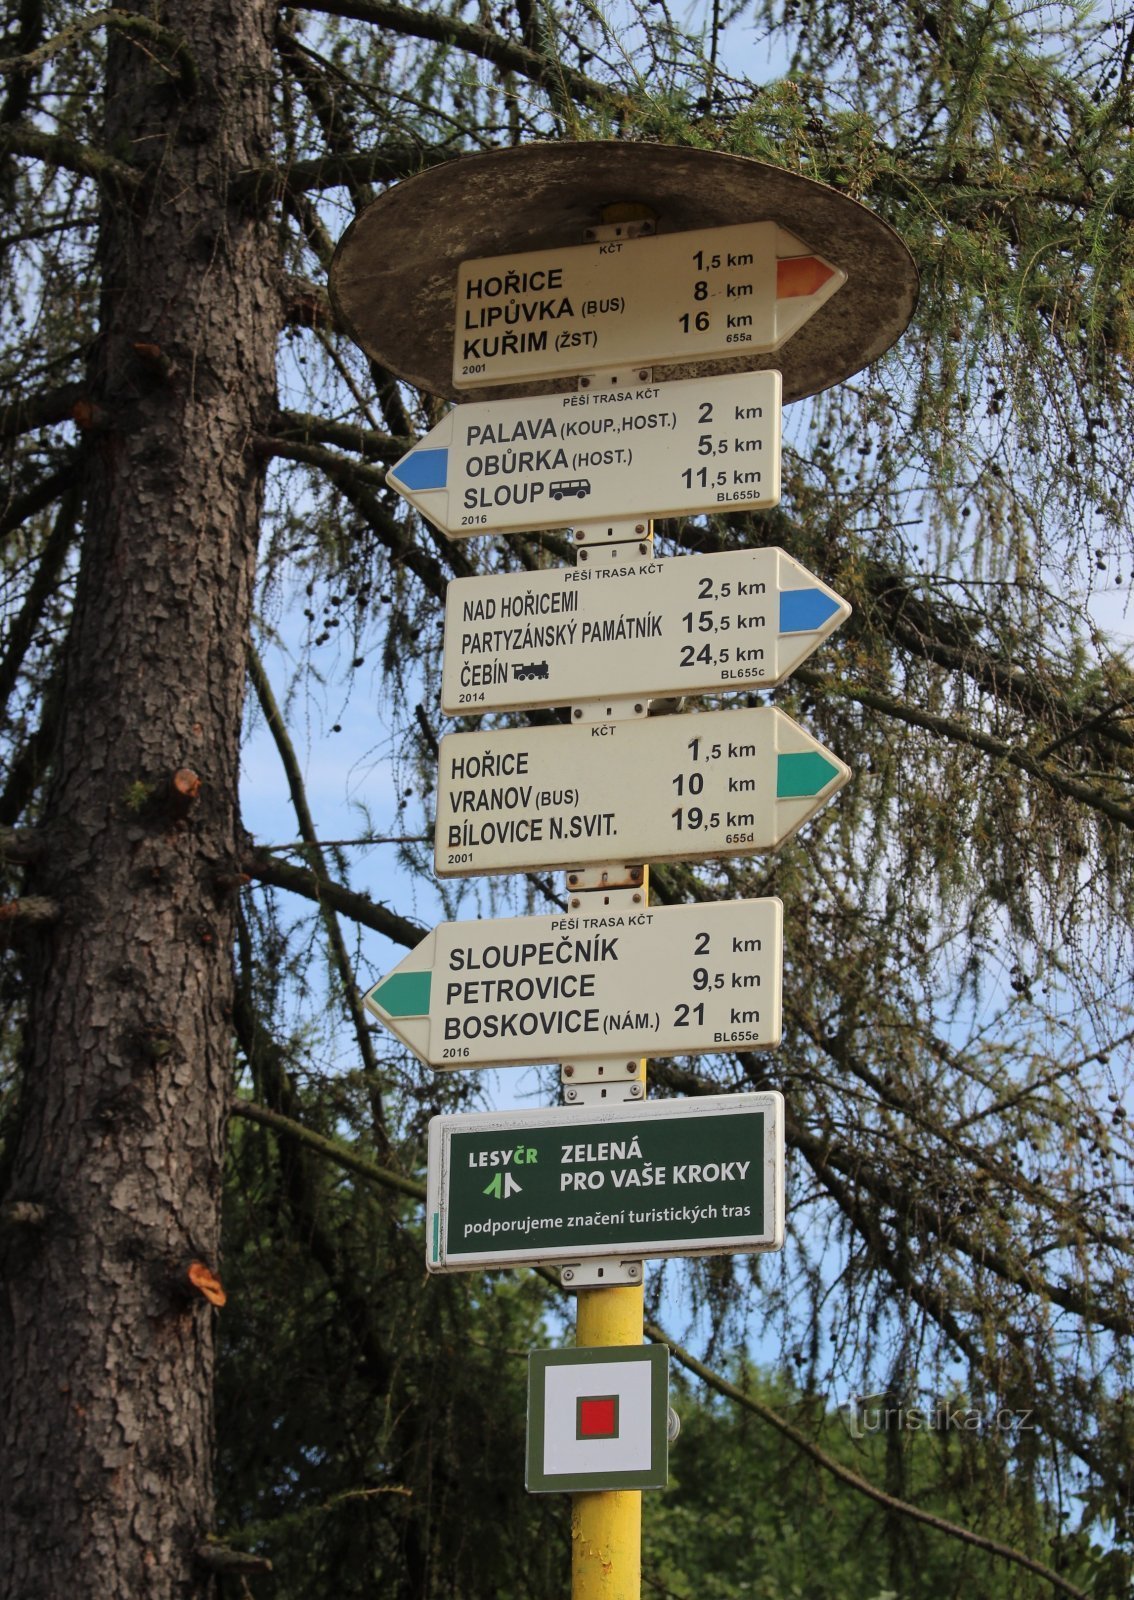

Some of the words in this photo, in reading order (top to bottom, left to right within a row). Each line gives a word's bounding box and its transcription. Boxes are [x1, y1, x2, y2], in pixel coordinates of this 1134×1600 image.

[599, 243, 622, 254] KČT
[466, 268, 563, 299] HOŘICE
[692, 251, 721, 272] 1,5
[727, 252, 754, 267] km
[464, 297, 574, 329] LIPŮVKA
[581, 297, 625, 318] (BUS)
[694, 281, 708, 301] 8
[726, 283, 753, 297] km
[463, 330, 548, 359] KUŘIM
[555, 330, 598, 352] (ŽST)
[679, 311, 710, 333] 16
[726, 313, 753, 327] km
[726, 333, 752, 343] 655a
[462, 365, 486, 374] 2001
[563, 393, 590, 407] PĚŠÍ
[593, 391, 633, 403] TRASA
[636, 388, 660, 400] KČT
[466, 418, 557, 446] PALAVA
[698, 403, 713, 423] 2
[735, 405, 762, 420] km
[465, 448, 568, 477] OBŮRKA
[572, 449, 633, 471] (HOST.)
[698, 435, 728, 457] 5,5
[734, 438, 762, 452] km
[463, 481, 544, 508] SLOUP
[681, 467, 727, 489] 11,5
[733, 470, 761, 484] km
[717, 490, 760, 502] BL655b
[461, 514, 487, 525] 2016
[564, 569, 592, 582] PĚŠÍ
[595, 567, 636, 579] TRASA
[639, 564, 663, 576] KČT
[463, 599, 496, 622] NAD
[501, 589, 578, 618] HOŘICEMI
[698, 578, 731, 600] 2,5
[738, 581, 765, 595] km
[462, 619, 577, 654] PARTYZÁNSKÝ
[582, 612, 662, 643] PAMÁTNÍK
[682, 611, 730, 634] 15,5
[737, 613, 765, 628] km
[460, 658, 508, 687] ČEBÍN
[680, 644, 729, 667] 24,5
[736, 648, 764, 662] km
[721, 667, 765, 679] BL655c
[459, 692, 485, 702] 2014
[591, 726, 616, 737] KČT
[451, 751, 528, 779] HOŘICE
[688, 738, 722, 762] 1,5
[728, 743, 756, 757] km
[450, 786, 532, 813] VRANOV
[536, 789, 579, 810] (BUS)
[672, 773, 703, 796] 10
[728, 778, 756, 792] km
[449, 819, 542, 847] BÍLOVICE
[550, 813, 617, 839] N.SVIT.
[672, 807, 720, 831] 19,5
[726, 812, 754, 827] km
[726, 833, 754, 844] 655d
[448, 853, 473, 864] 2001
[551, 918, 579, 931] PĚŠÍ
[583, 917, 624, 928] TRASA
[628, 914, 653, 926] KČT
[449, 934, 619, 971] SLOUPEČNÍK
[694, 932, 710, 955] 2
[732, 937, 761, 952] km
[446, 974, 596, 1005] PETROVICE
[693, 968, 724, 992] 9,5
[732, 973, 760, 988] km
[444, 1009, 600, 1040] BOSKOVICE
[603, 1011, 660, 1035] (NÁM.)
[673, 1003, 704, 1027] 21
[730, 1008, 760, 1023] km
[714, 1031, 759, 1042] BL655e
[442, 1048, 470, 1058] 2016
[561, 1136, 642, 1163] ZELENÁ
[560, 1171, 605, 1191] PRO
[611, 1163, 666, 1188] VAŠE
[672, 1161, 750, 1184] KROKY
[464, 1215, 562, 1237] podporujeme
[567, 1211, 625, 1227] značení
[628, 1205, 717, 1224] turistických
[722, 1204, 750, 1218] tras
